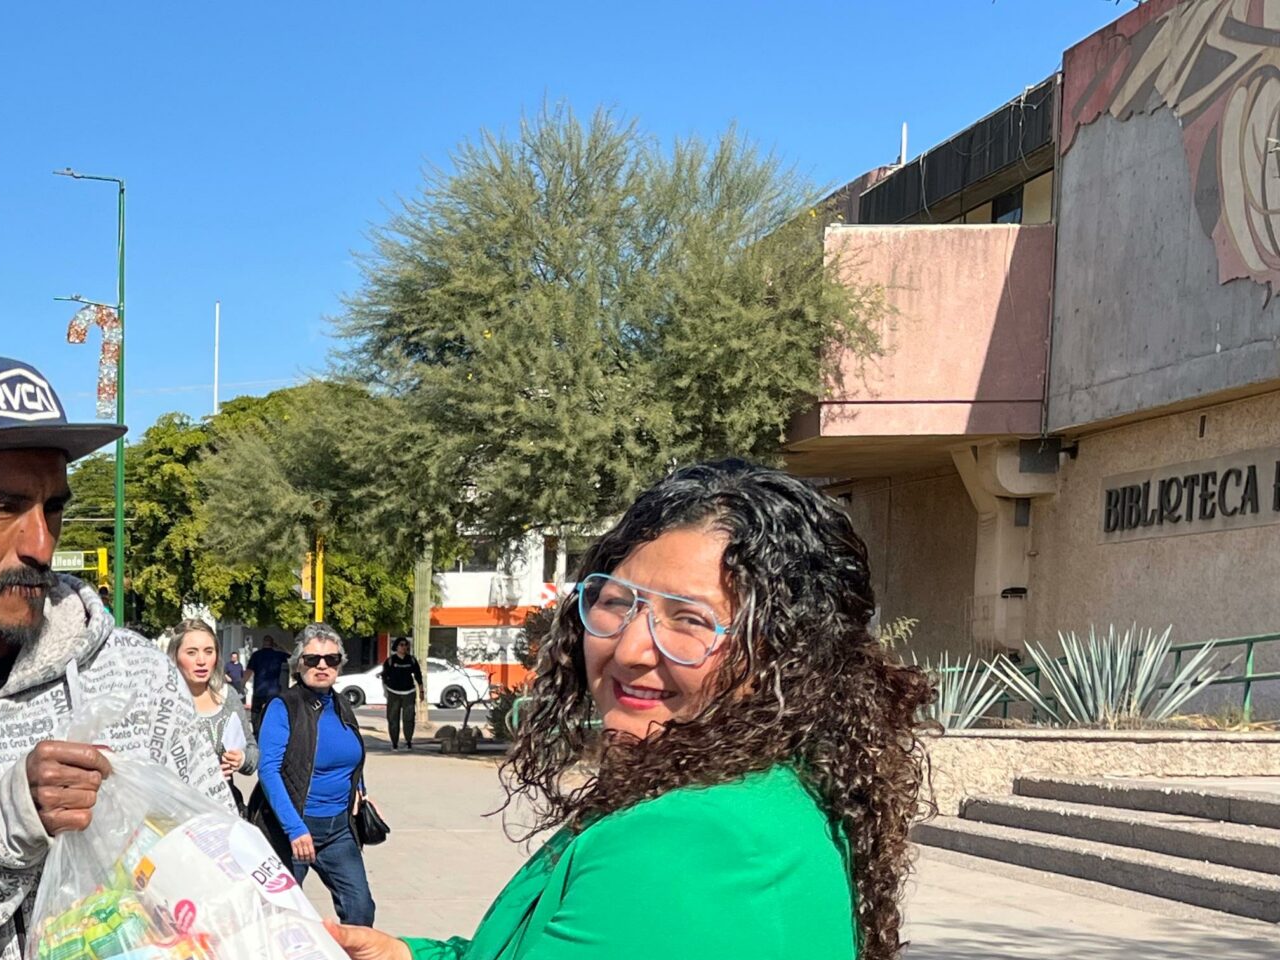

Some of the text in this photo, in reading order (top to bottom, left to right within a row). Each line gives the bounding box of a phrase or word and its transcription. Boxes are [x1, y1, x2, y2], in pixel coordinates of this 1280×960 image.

[1103, 464, 1260, 533] BIBLIOTECA
[51, 689, 71, 715] SAN
[157, 698, 175, 723] SAN
[9, 737, 28, 750] Cruz
[170, 746, 190, 784] DIEGO
[251, 860, 275, 886] DIF
